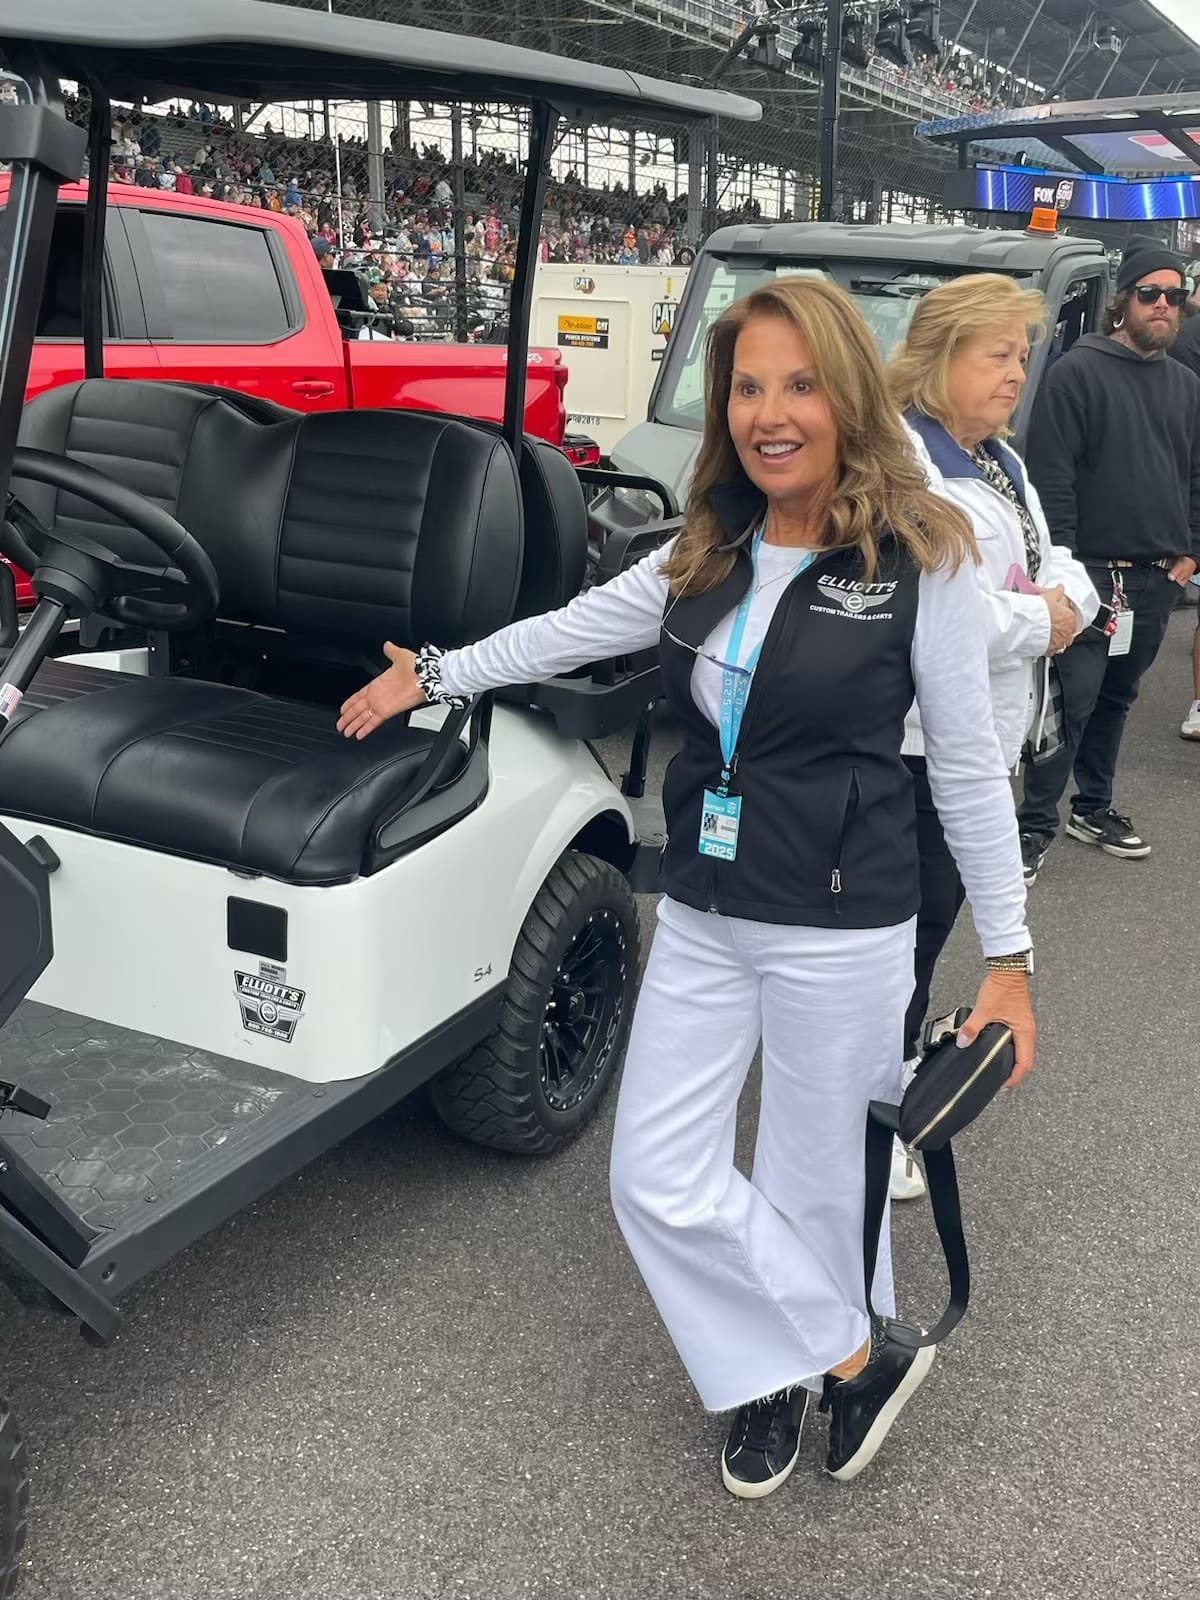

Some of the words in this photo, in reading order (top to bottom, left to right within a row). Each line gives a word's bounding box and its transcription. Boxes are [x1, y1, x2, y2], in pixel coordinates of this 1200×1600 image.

[1034, 187, 1055, 203] FOX
[574, 278, 591, 290] CAT
[652, 303, 677, 333] CAT
[817, 575, 899, 593] ELLIOTT'S
[809, 604, 836, 615] CUSTOM
[836, 610, 867, 620] TRAILERS
[704, 841, 735, 860] 2025
[474, 963, 492, 982] S4
[242, 976, 300, 1002] ELLIOTT'S
